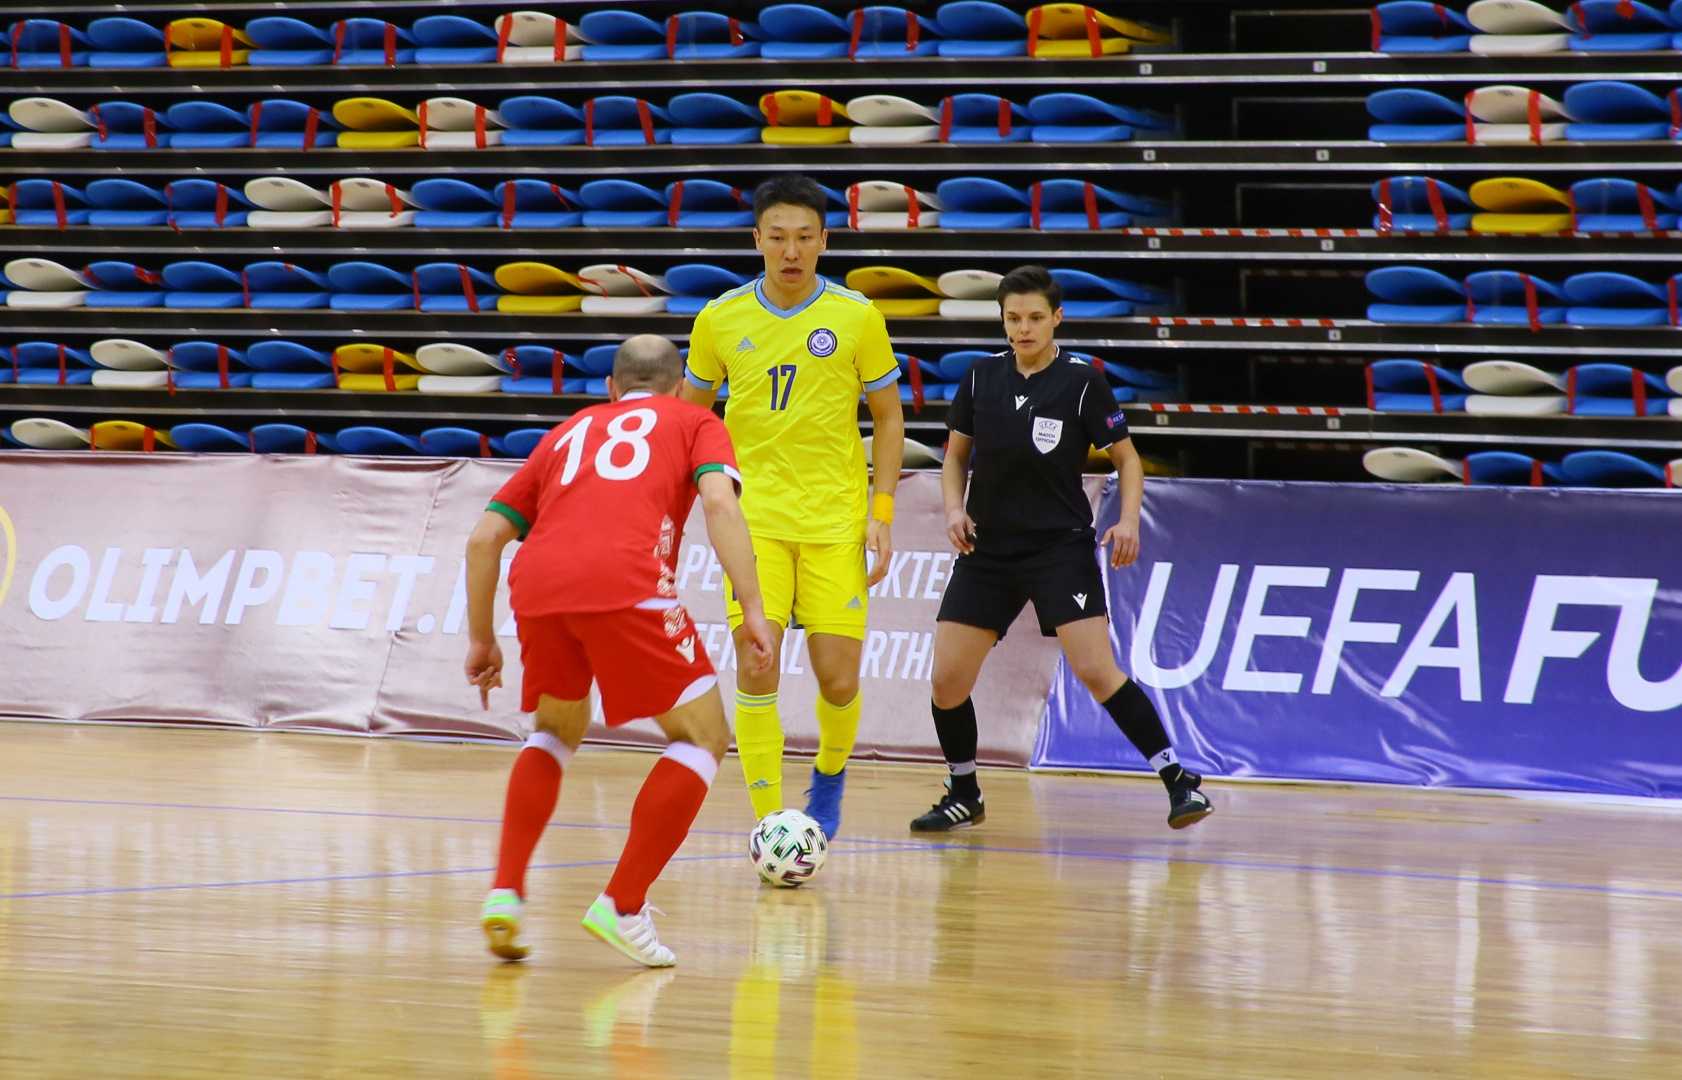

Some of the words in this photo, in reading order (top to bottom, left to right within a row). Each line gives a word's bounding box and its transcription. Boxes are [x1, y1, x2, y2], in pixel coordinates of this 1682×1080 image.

[767, 365, 797, 411] 17
[554, 408, 658, 486] 18
[29, 544, 517, 636] OLIMPBET.
[1131, 561, 1482, 702] UEFA
